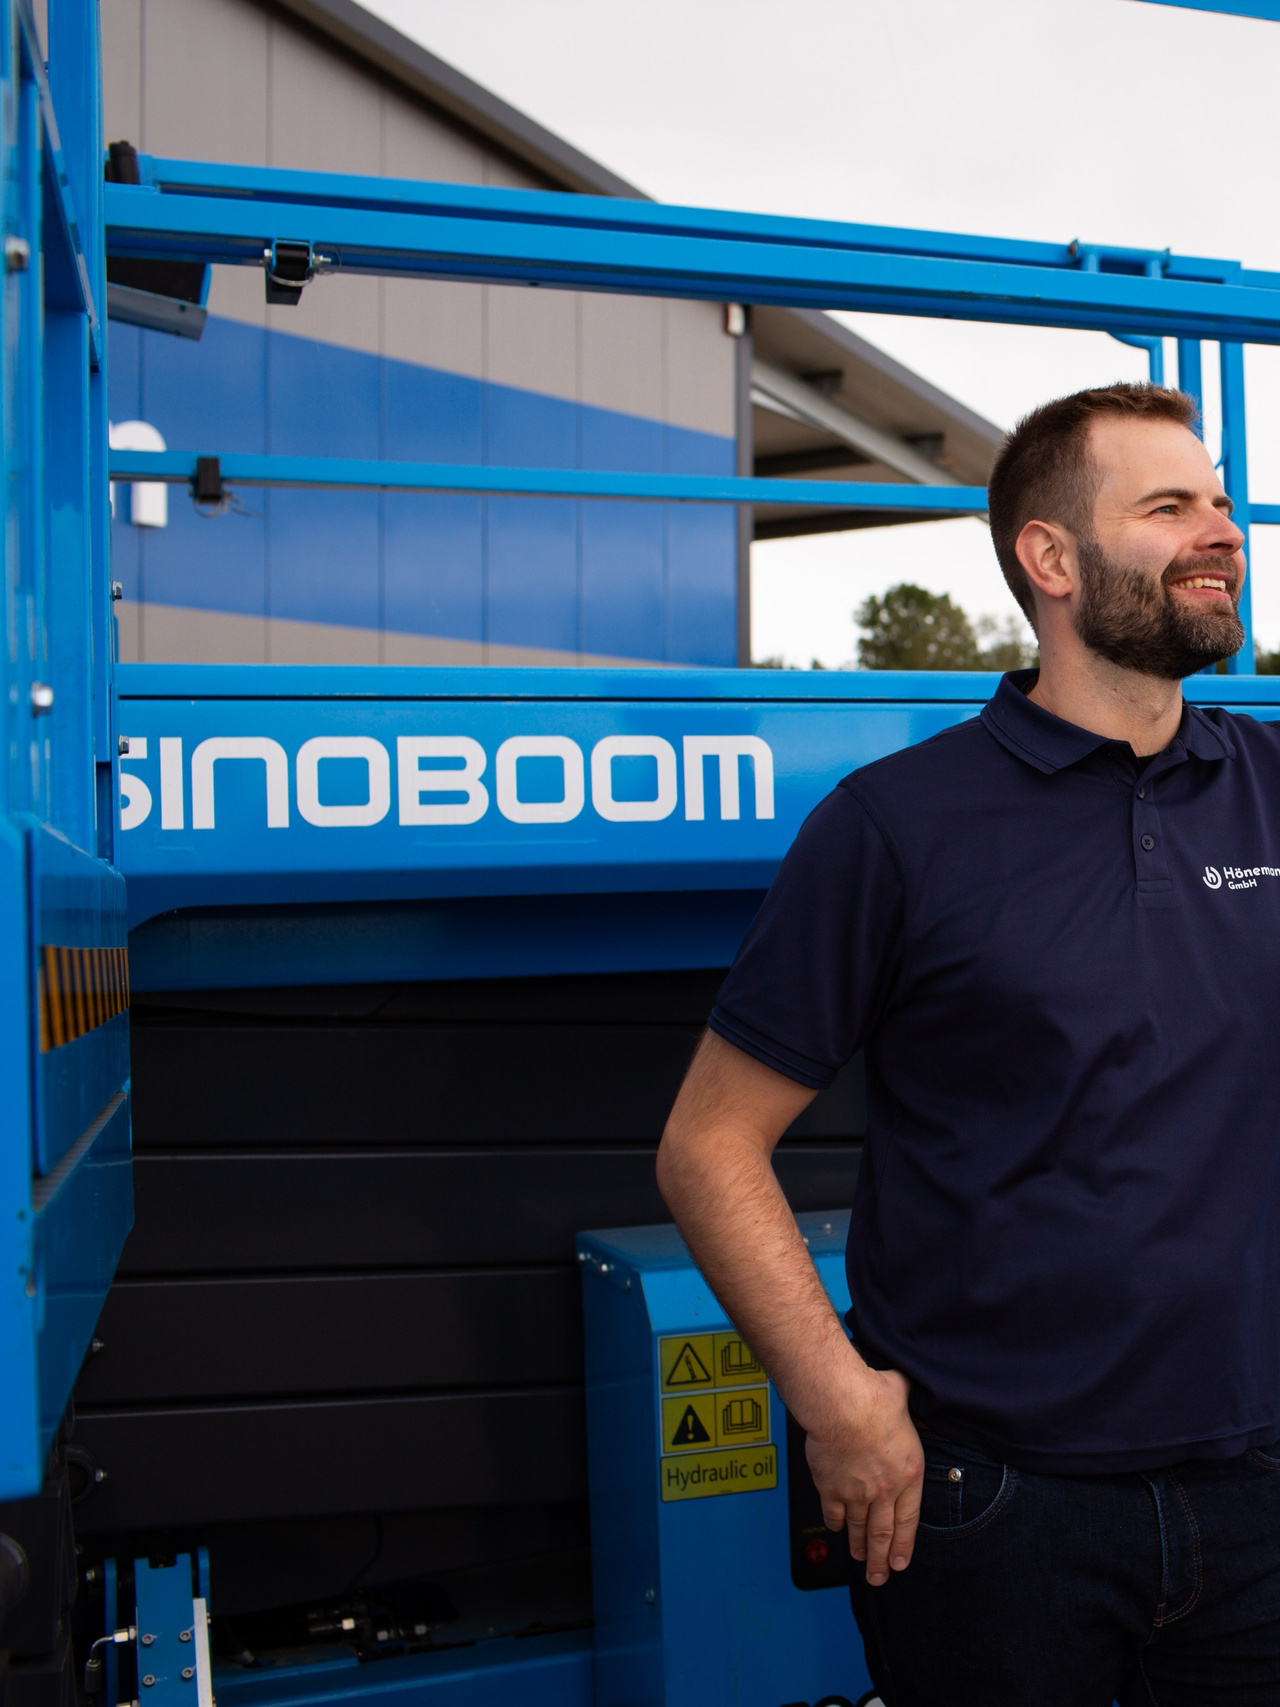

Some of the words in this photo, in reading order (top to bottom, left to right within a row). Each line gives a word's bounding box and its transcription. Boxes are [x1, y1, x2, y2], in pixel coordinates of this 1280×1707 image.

[1228, 879, 1258, 890] GmbH
[667, 1460, 748, 1492] Hydraulic
[753, 1455, 773, 1477] oil
